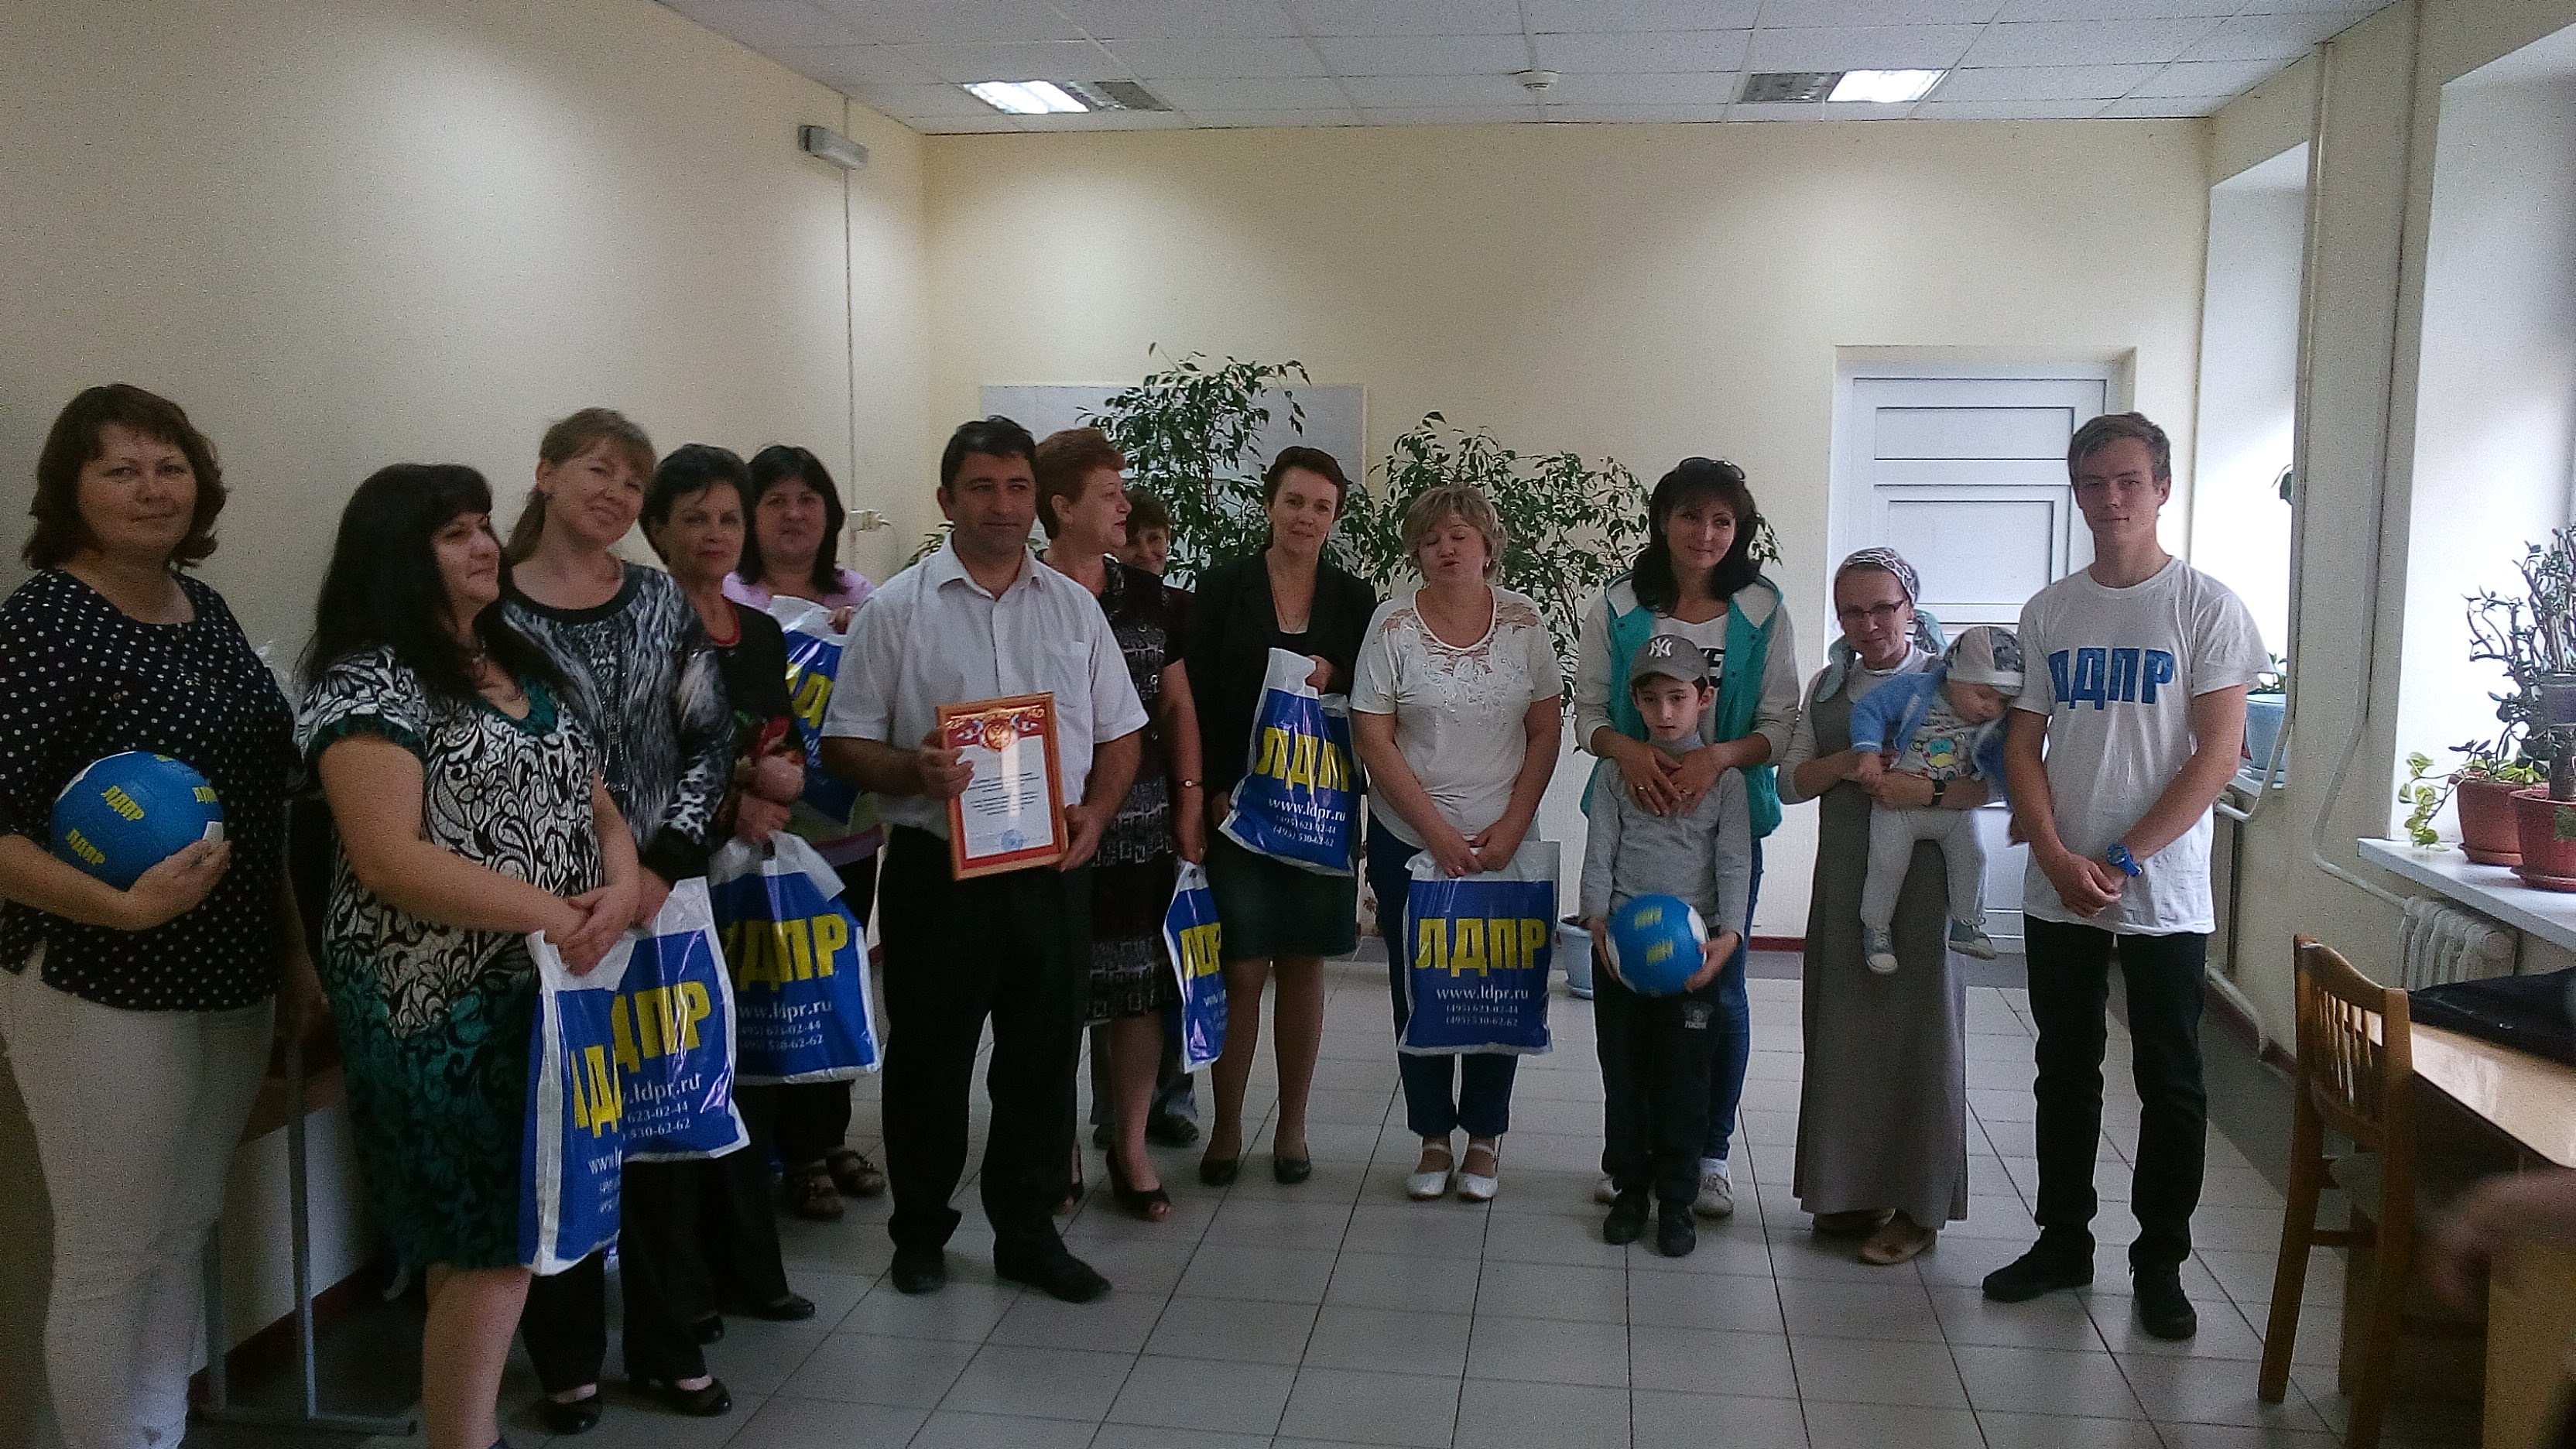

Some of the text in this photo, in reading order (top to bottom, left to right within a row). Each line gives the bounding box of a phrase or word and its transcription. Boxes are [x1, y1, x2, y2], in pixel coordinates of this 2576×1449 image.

[1648, 638, 1672, 657] NY
[2048, 648, 2174, 710] ЛДПР
[1269, 798, 1346, 821] www.ldpr.ru
[1416, 918, 1546, 977] ЛДПР
[1437, 985, 1529, 1003] www.ldpr.ru
